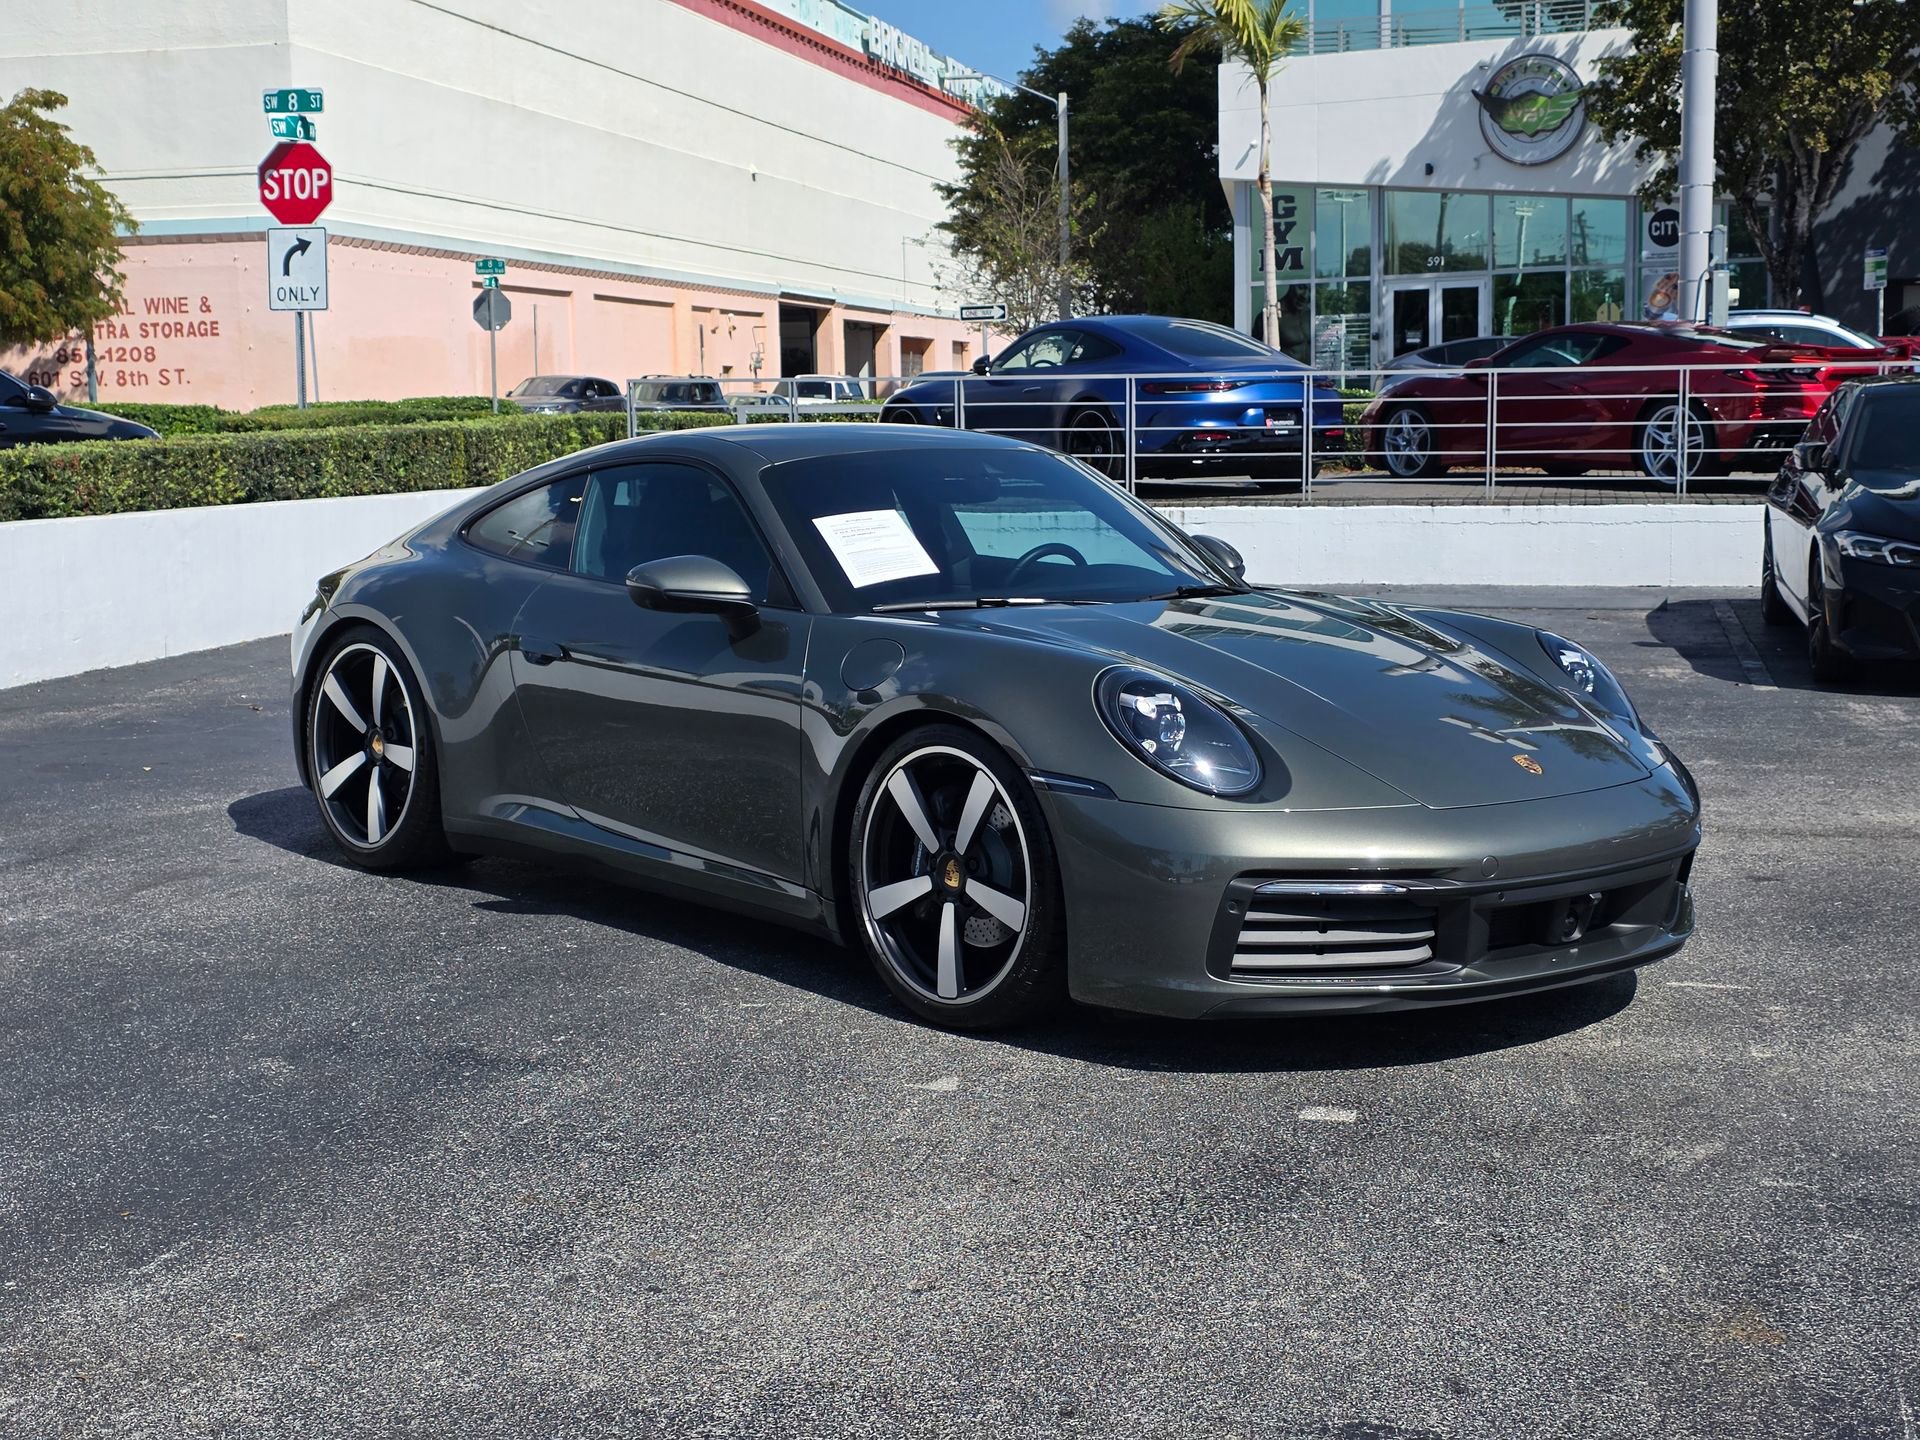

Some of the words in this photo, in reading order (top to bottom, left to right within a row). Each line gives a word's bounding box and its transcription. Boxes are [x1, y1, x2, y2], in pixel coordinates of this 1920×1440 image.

[868, 15, 936, 84] BRICKELL
[265, 95, 278, 110] SW
[288, 92, 298, 111] 8
[310, 95, 321, 108] ST
[272, 120, 287, 134] SW
[296, 120, 304, 139] 6
[263, 168, 329, 200] STOP
[1258, 194, 1304, 272] GYM
[1426, 255, 1445, 267] 591
[276, 286, 320, 302] ONLY
[144, 297, 189, 316] WINE
[199, 296, 212, 314] &
[139, 320, 220, 339] STORAGE
[56, 346, 157, 365] 85-1208
[29, 371, 61, 388] 601
[116, 369, 149, 387] 8th
[158, 368, 191, 386] ST.
